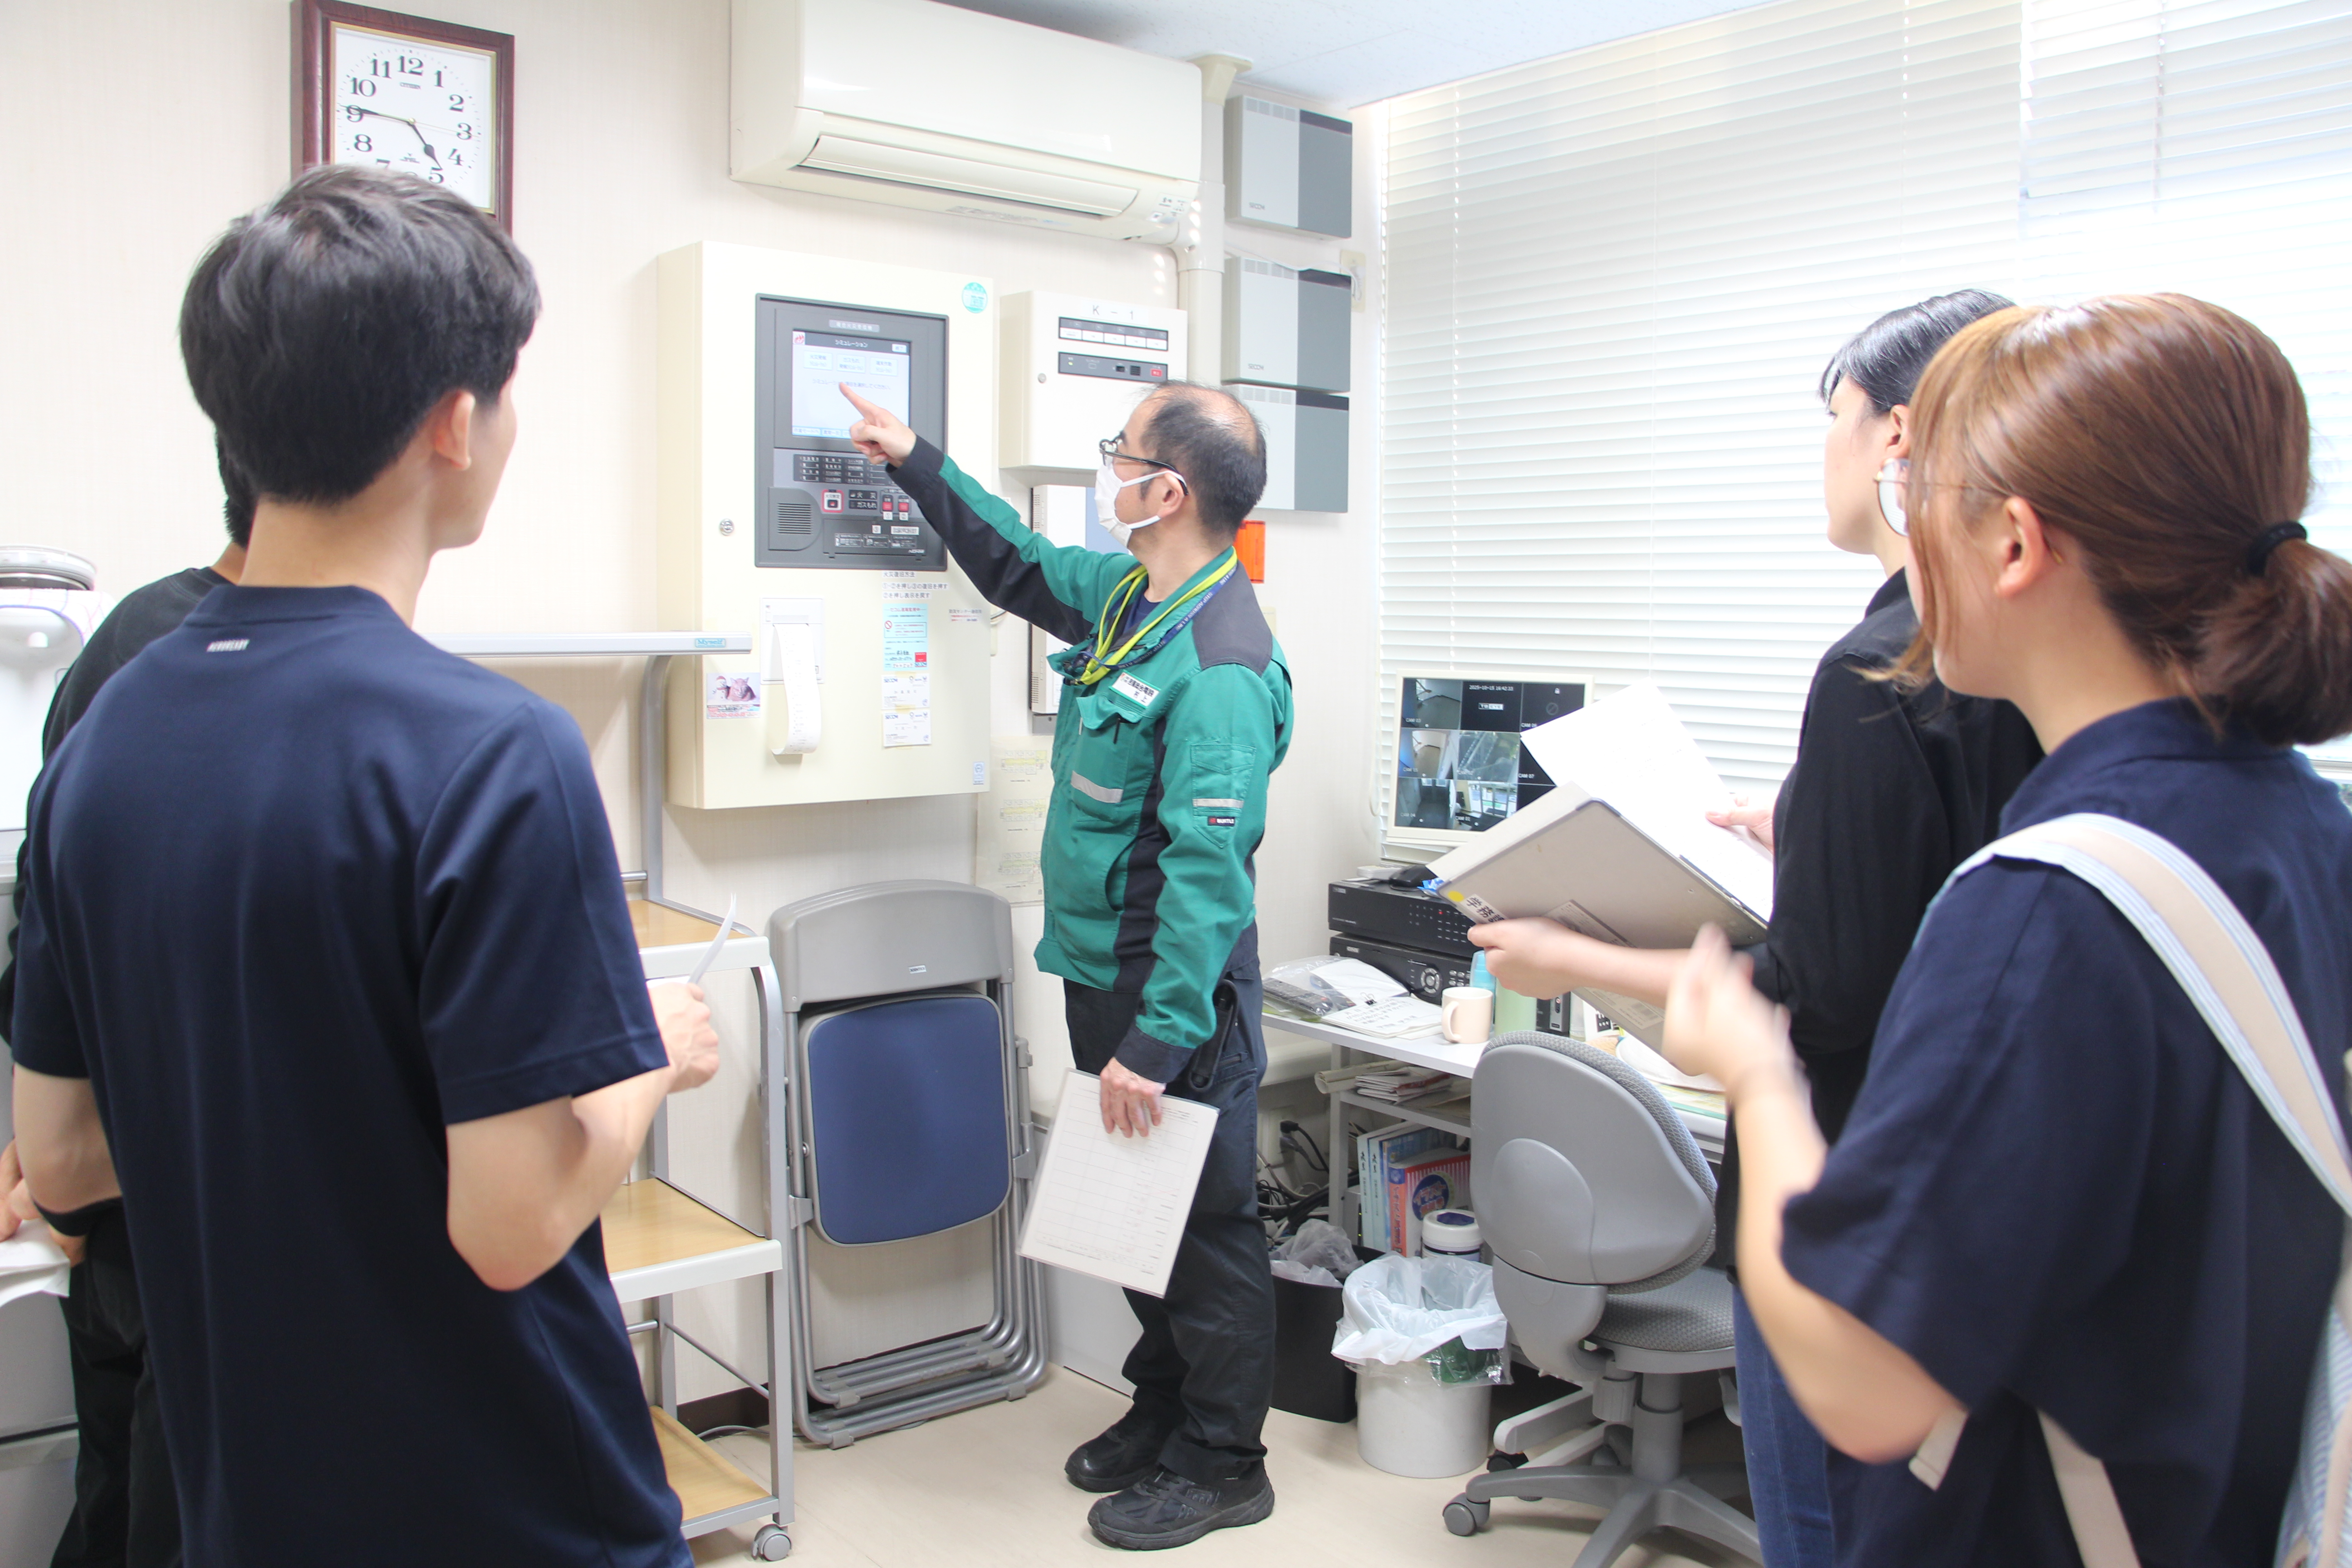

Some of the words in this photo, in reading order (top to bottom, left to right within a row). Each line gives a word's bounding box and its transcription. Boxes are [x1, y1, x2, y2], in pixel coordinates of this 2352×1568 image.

[372, 58, 390, 78] 11
[398, 55, 424, 76] 12
[351, 77, 376, 97] 10
[434, 71, 444, 88] 1
[450, 94, 464, 112] 2
[346, 105, 364, 122] 9
[456, 123, 473, 140] 3
[354, 134, 372, 152] 8
[448, 148, 464, 166] 4
[428, 167, 443, 184] 5
